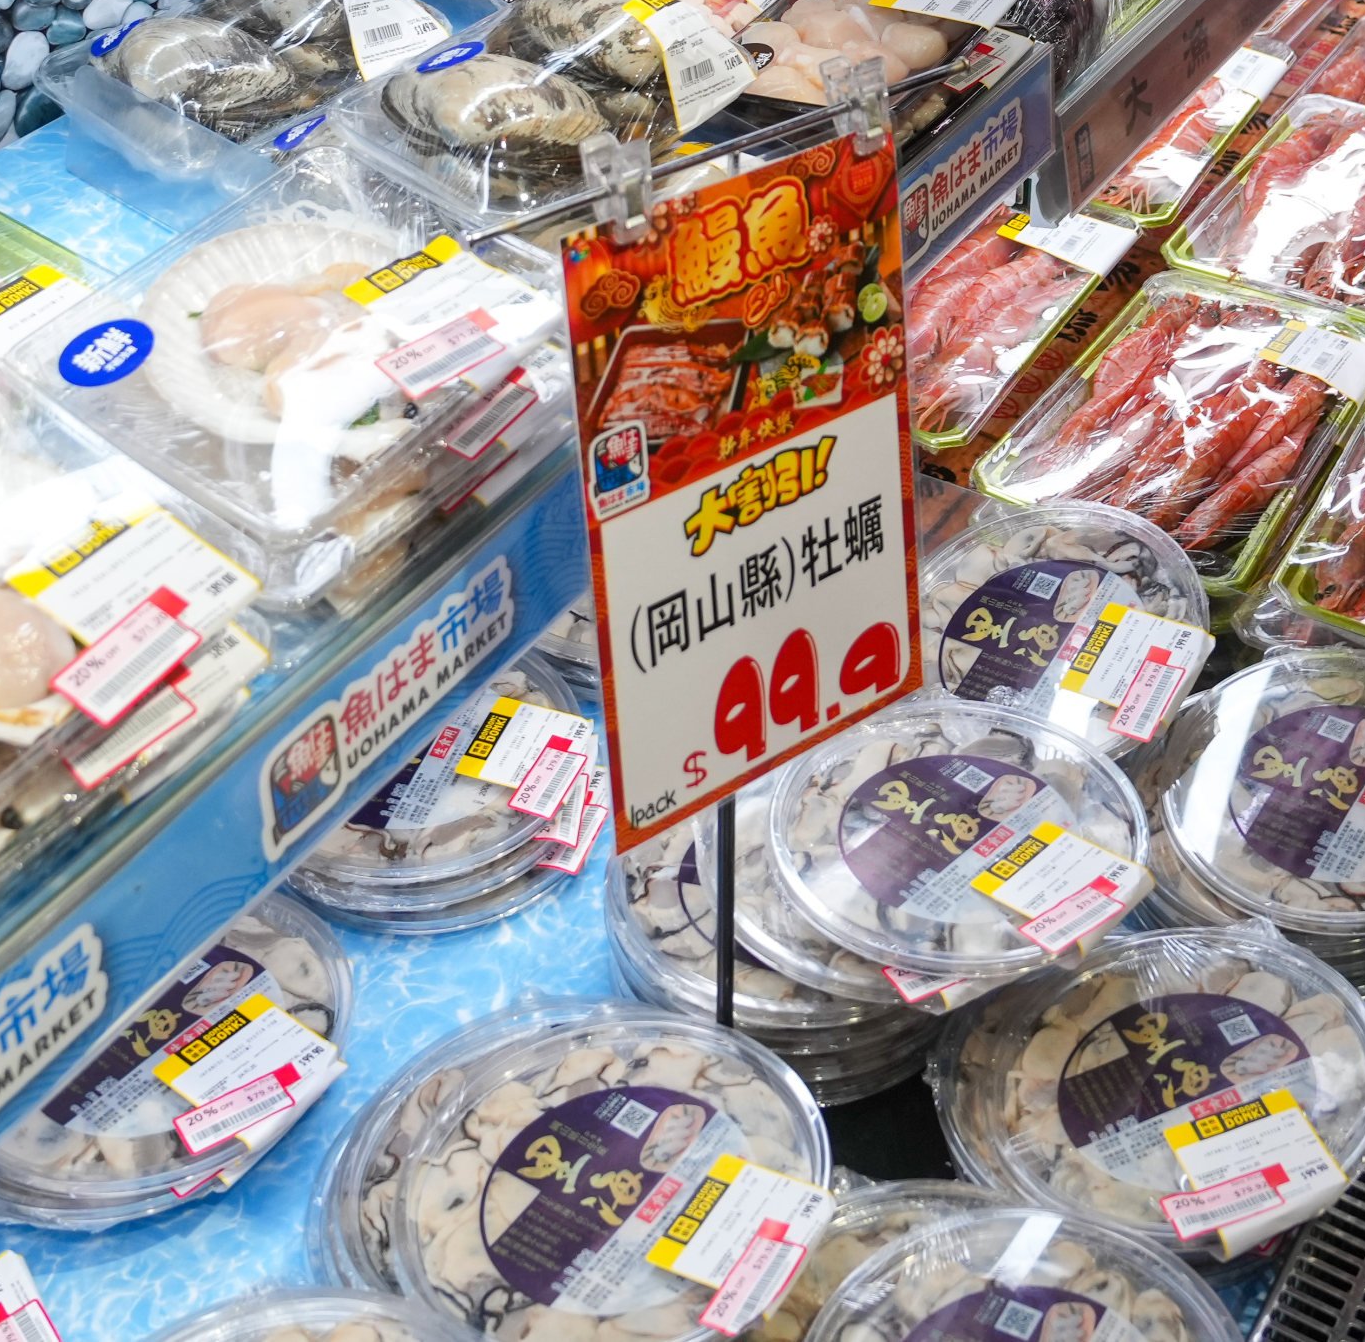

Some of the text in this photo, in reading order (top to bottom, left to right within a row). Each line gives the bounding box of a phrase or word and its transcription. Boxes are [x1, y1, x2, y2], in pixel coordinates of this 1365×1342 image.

[930, 107, 1019, 210] 魚はま市場
[931, 142, 1020, 233] UOHAMA MARKET
[672, 182, 807, 303] 鰻魚
[743, 272, 790, 328] Eel
[70, 323, 135, 376] 新鮮
[389, 347, 423, 372] 20%
[719, 410, 795, 459] 新年快樂
[131, 611, 170, 644] $71.20
[1090, 625, 1115, 656] DONKI
[1172, 629, 1193, 652] $99.90
[68, 654, 106, 688] 20%
[339, 573, 505, 741] 魚はま市場
[347, 612, 509, 769] UOHAMA MARKET
[1144, 663, 1163, 689] $79.92
[487, 716, 510, 744] DONKI
[1116, 703, 1137, 728] 20%
[433, 727, 459, 758] 生食用
[545, 750, 565, 772] $79.92
[517, 783, 538, 805] 20%
[973, 827, 1013, 857] 生食用
[1014, 841, 1046, 869] DONKI
[1106, 862, 1131, 884] $99.90
[1076, 889, 1103, 911] $79.92
[1028, 913, 1058, 935] 20%
[166, 1021, 210, 1055] 生食用
[207, 1016, 248, 1051] DONKI
[298, 1044, 327, 1070] $99.90
[1121, 1013, 1221, 1108] 里海
[246, 1082, 282, 1104] $79.92
[1189, 1091, 1243, 1121] 生食用
[184, 1104, 221, 1129] 20%
[1221, 1105, 1267, 1132] DONKI
[1298, 1162, 1330, 1182] $99.90
[638, 1178, 684, 1224] 生食用
[692, 1181, 728, 1223] DONKI
[1172, 1191, 1206, 1210] 20%
[1233, 1179, 1270, 1198] $79.92
[800, 1191, 824, 1221] $99.90
[751, 1238, 778, 1271] $79.92
[711, 1287, 738, 1320] 20%
